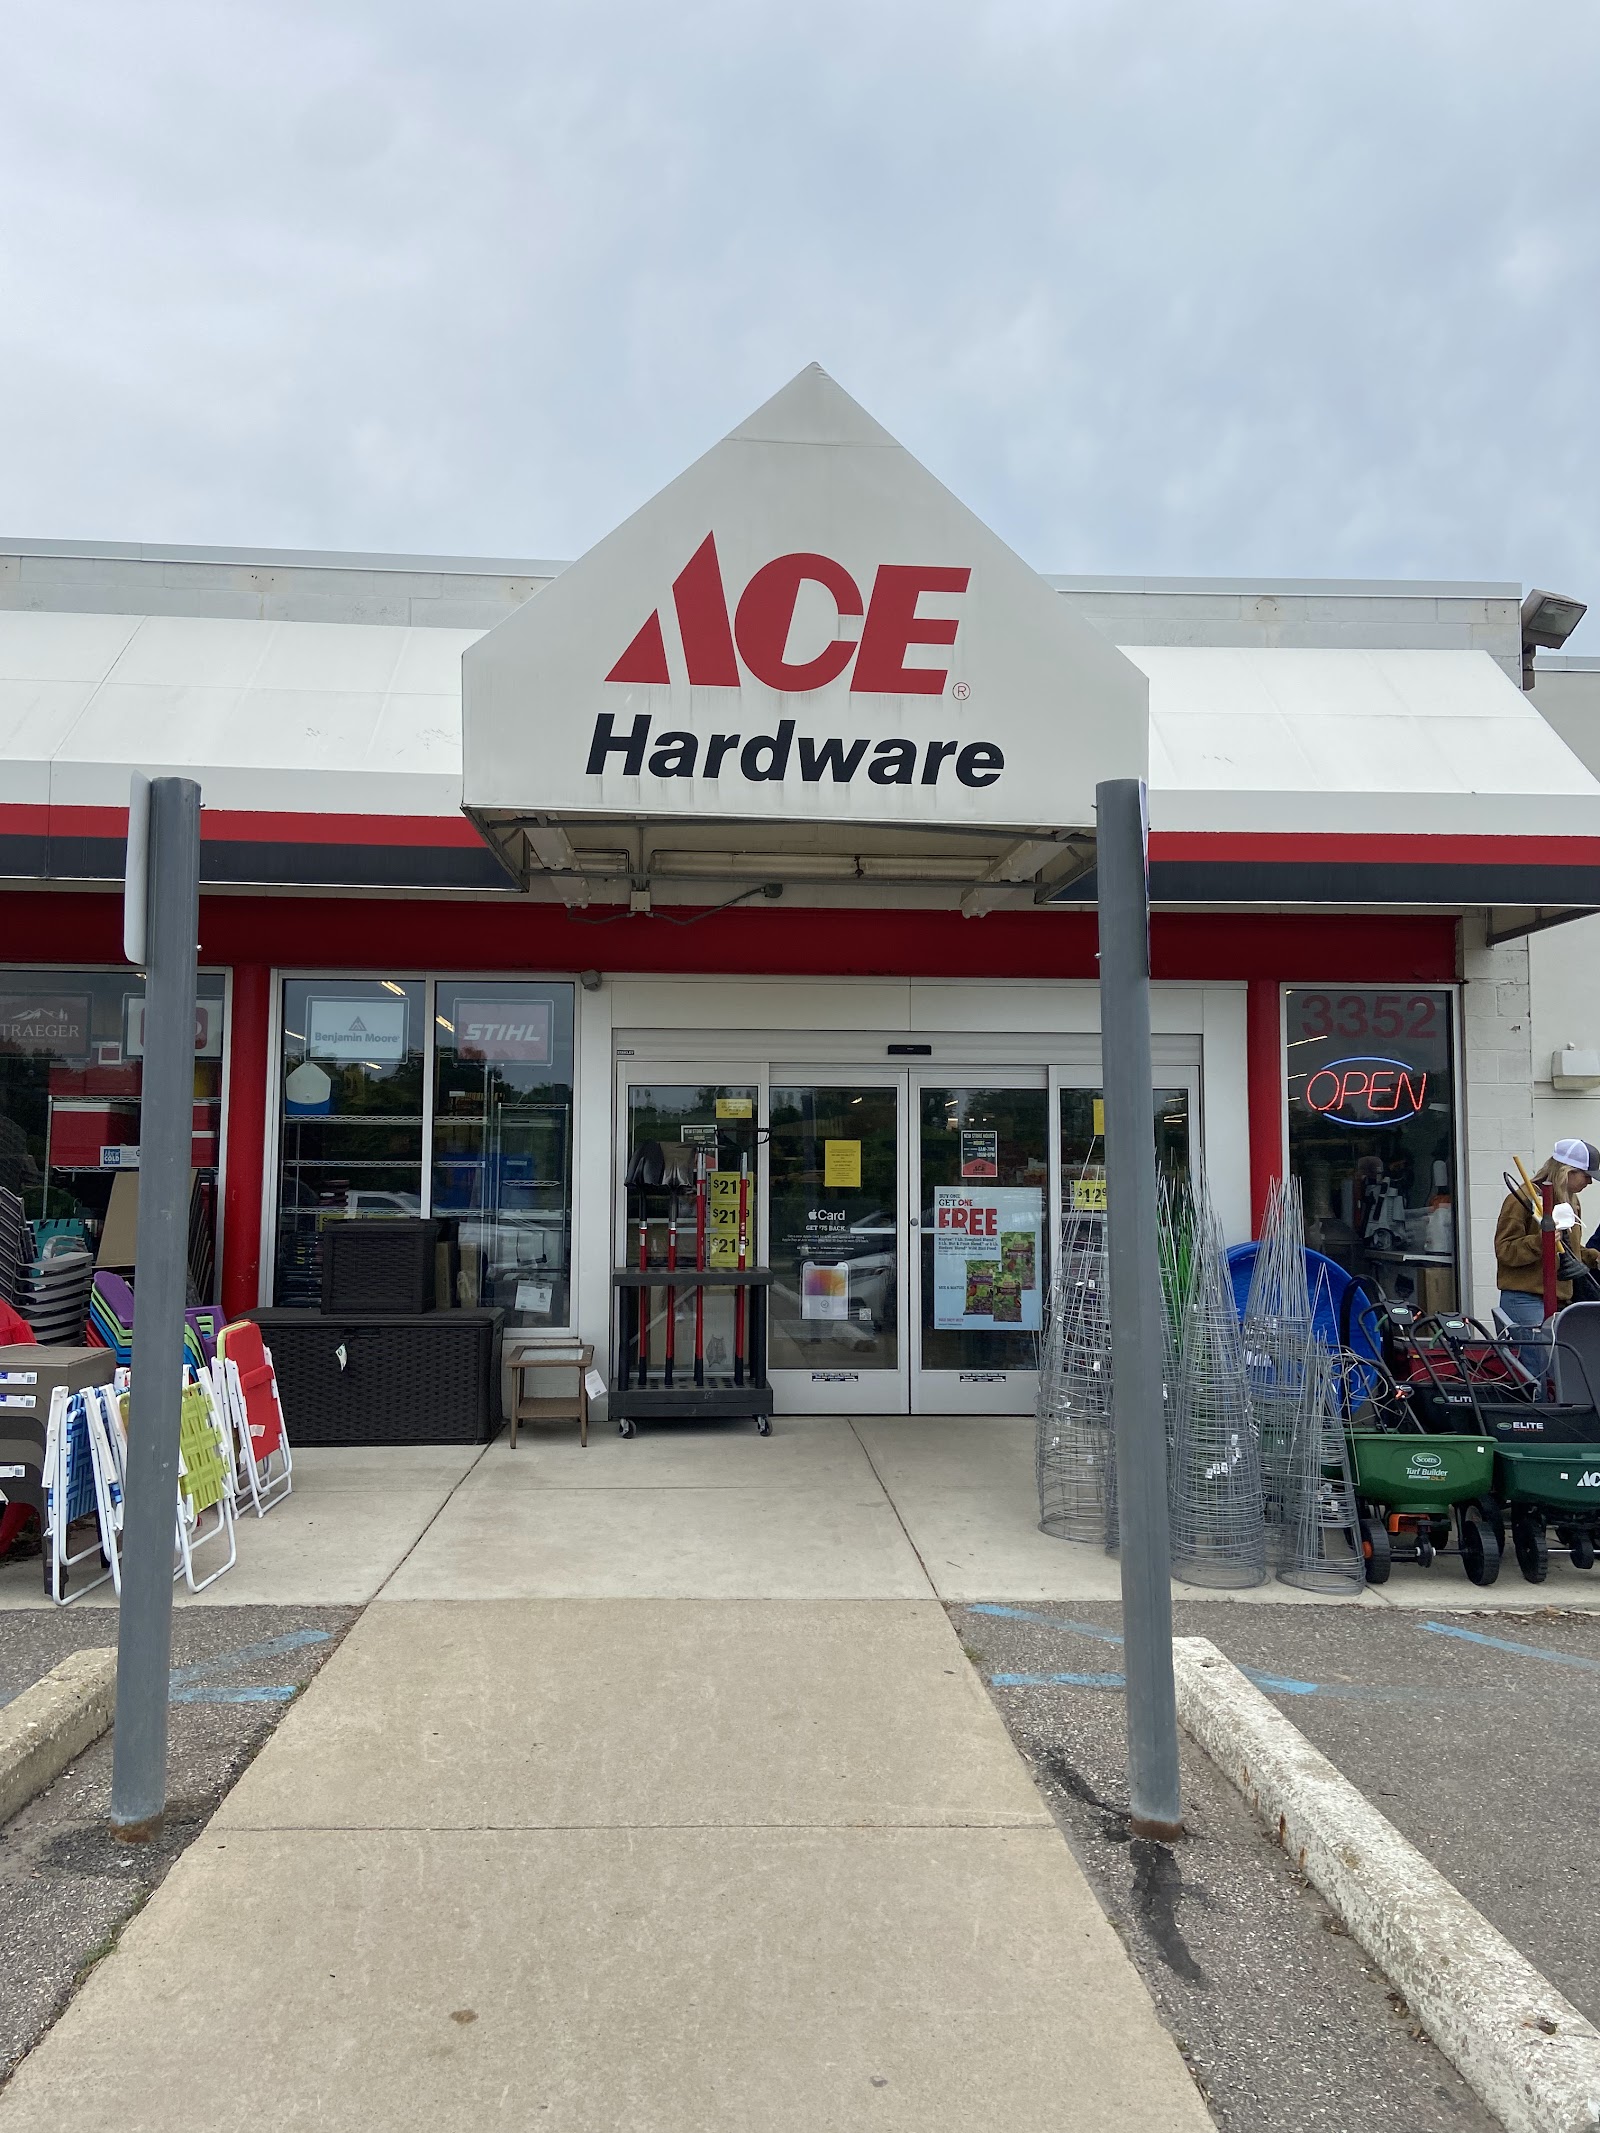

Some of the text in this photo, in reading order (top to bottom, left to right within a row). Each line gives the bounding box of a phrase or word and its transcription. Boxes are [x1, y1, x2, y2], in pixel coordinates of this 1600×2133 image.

[604, 529, 972, 695] ACE
[585, 712, 1005, 788] Hardware
[1301, 994, 1438, 1039] 3352
[0, 1024, 79, 1038] TRAEGER
[314, 1031, 398, 1043] Benjamin Moore
[464, 1023, 541, 1042] STIHL
[1306, 1070, 1427, 1111] OPEN
[938, 1198, 973, 1207] GET ONE
[817, 1209, 846, 1221] Card
[938, 1207, 998, 1236] FREE
[1512, 1421, 1544, 1429] ELITE
[1405, 1467, 1421, 1475] Turf
[1421, 1468, 1449, 1477] Builder
[1575, 1470, 1600, 1487] AC
